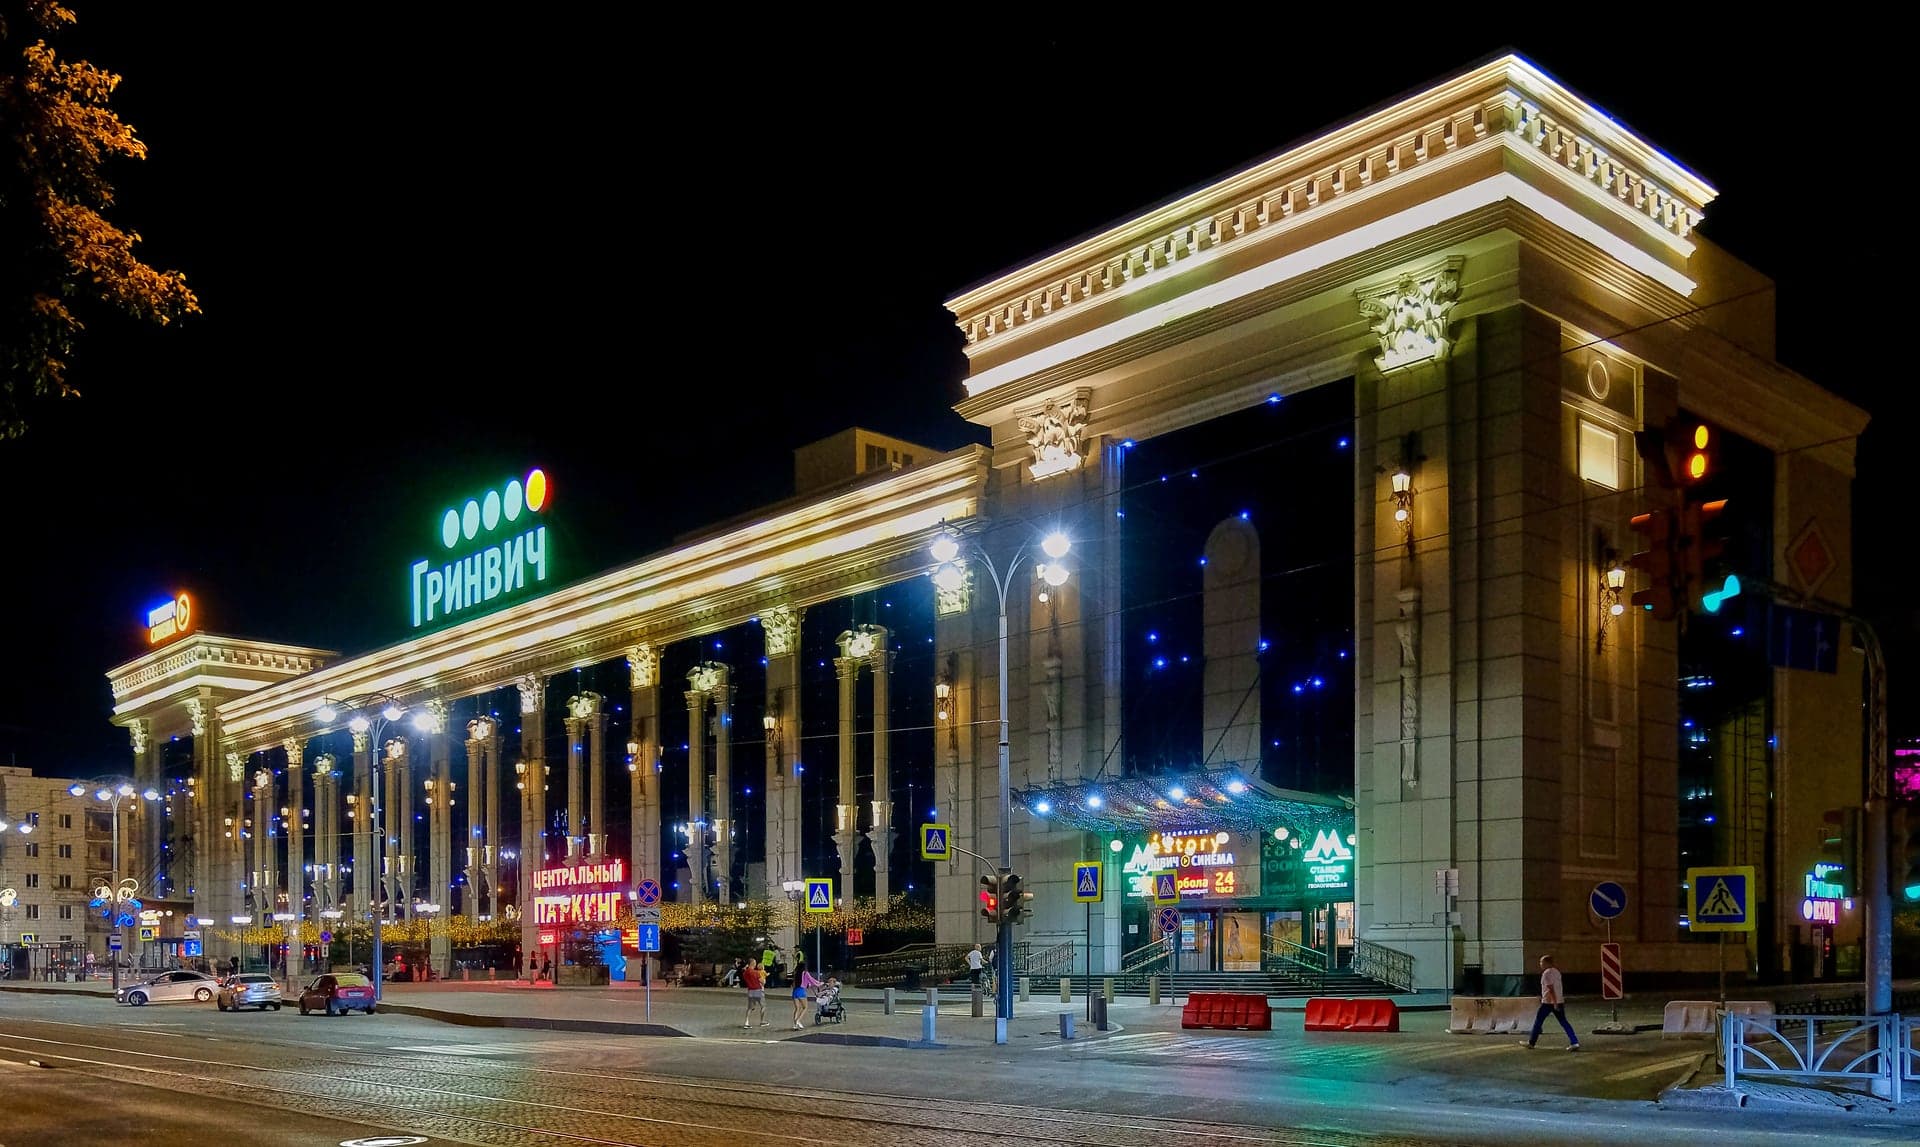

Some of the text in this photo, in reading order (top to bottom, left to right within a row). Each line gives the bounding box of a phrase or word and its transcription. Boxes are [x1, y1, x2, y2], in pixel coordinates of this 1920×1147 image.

[1191, 852, 1234, 867] СИНЕМА
[533, 858, 623, 891] ЦЕНТРАЛЬНЫЙ
[1215, 871, 1235, 886] 24
[534, 892, 621, 924] ПАРКИНГ
